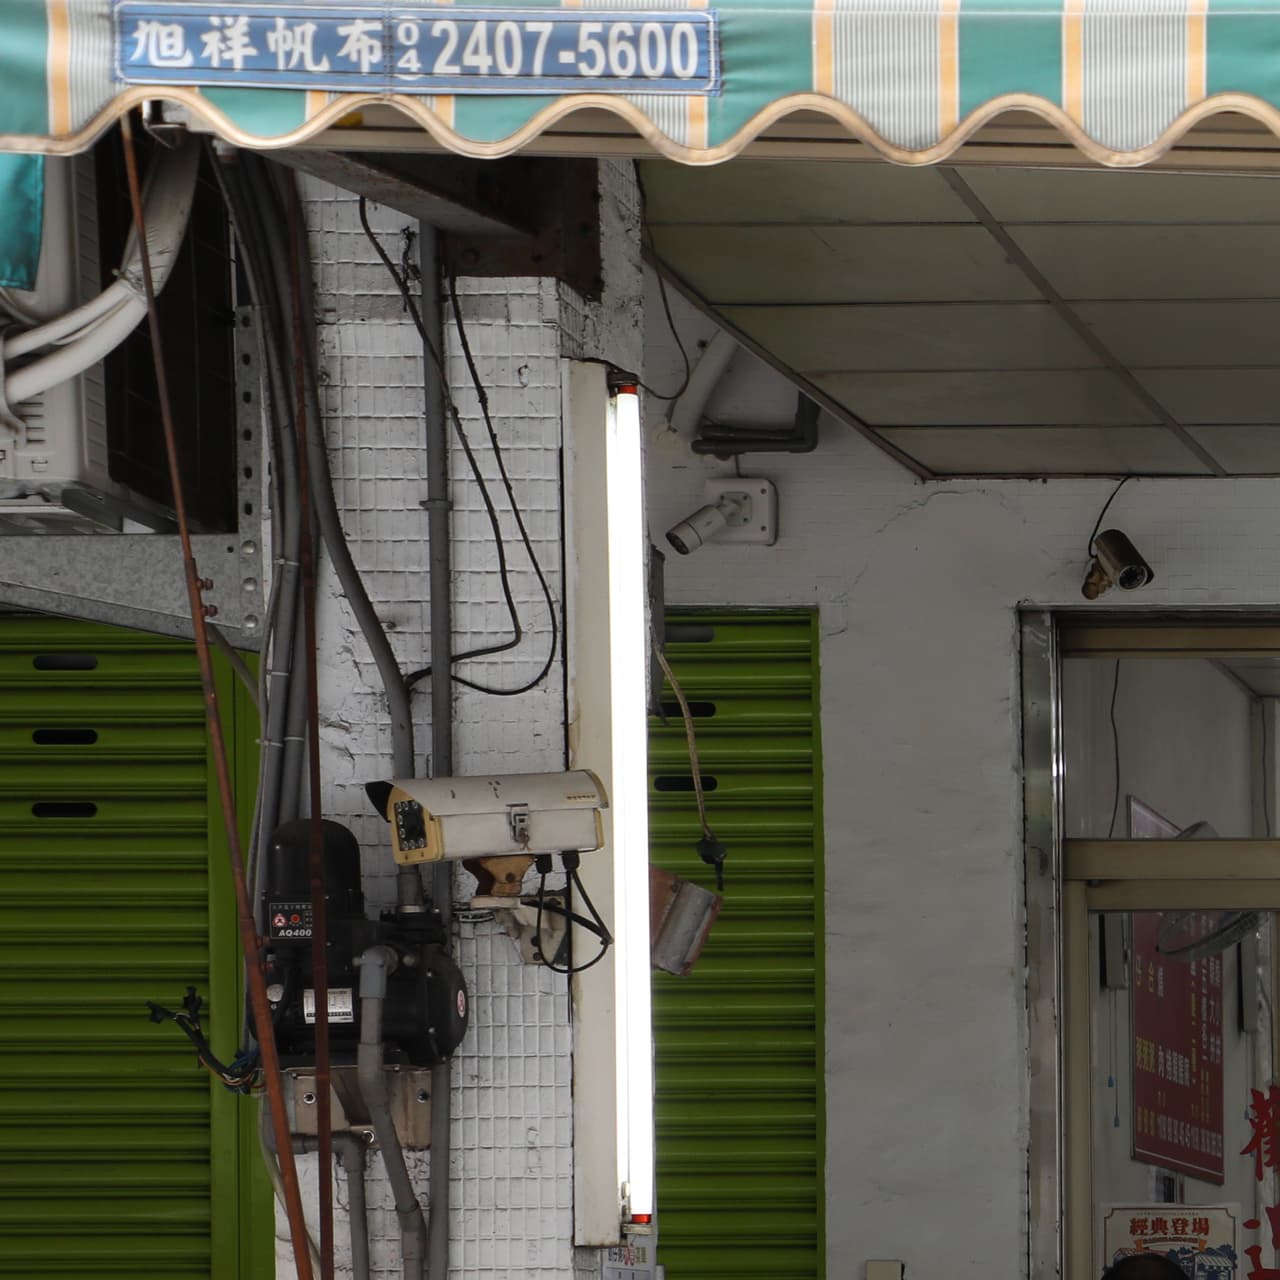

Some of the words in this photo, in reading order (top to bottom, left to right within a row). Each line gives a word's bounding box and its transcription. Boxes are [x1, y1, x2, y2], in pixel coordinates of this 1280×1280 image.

[131, 16, 382, 72] 旭祥帆布
[432, 20, 699, 79] 2407-5600
[1128, 1217, 1210, 1237] 經典登場
